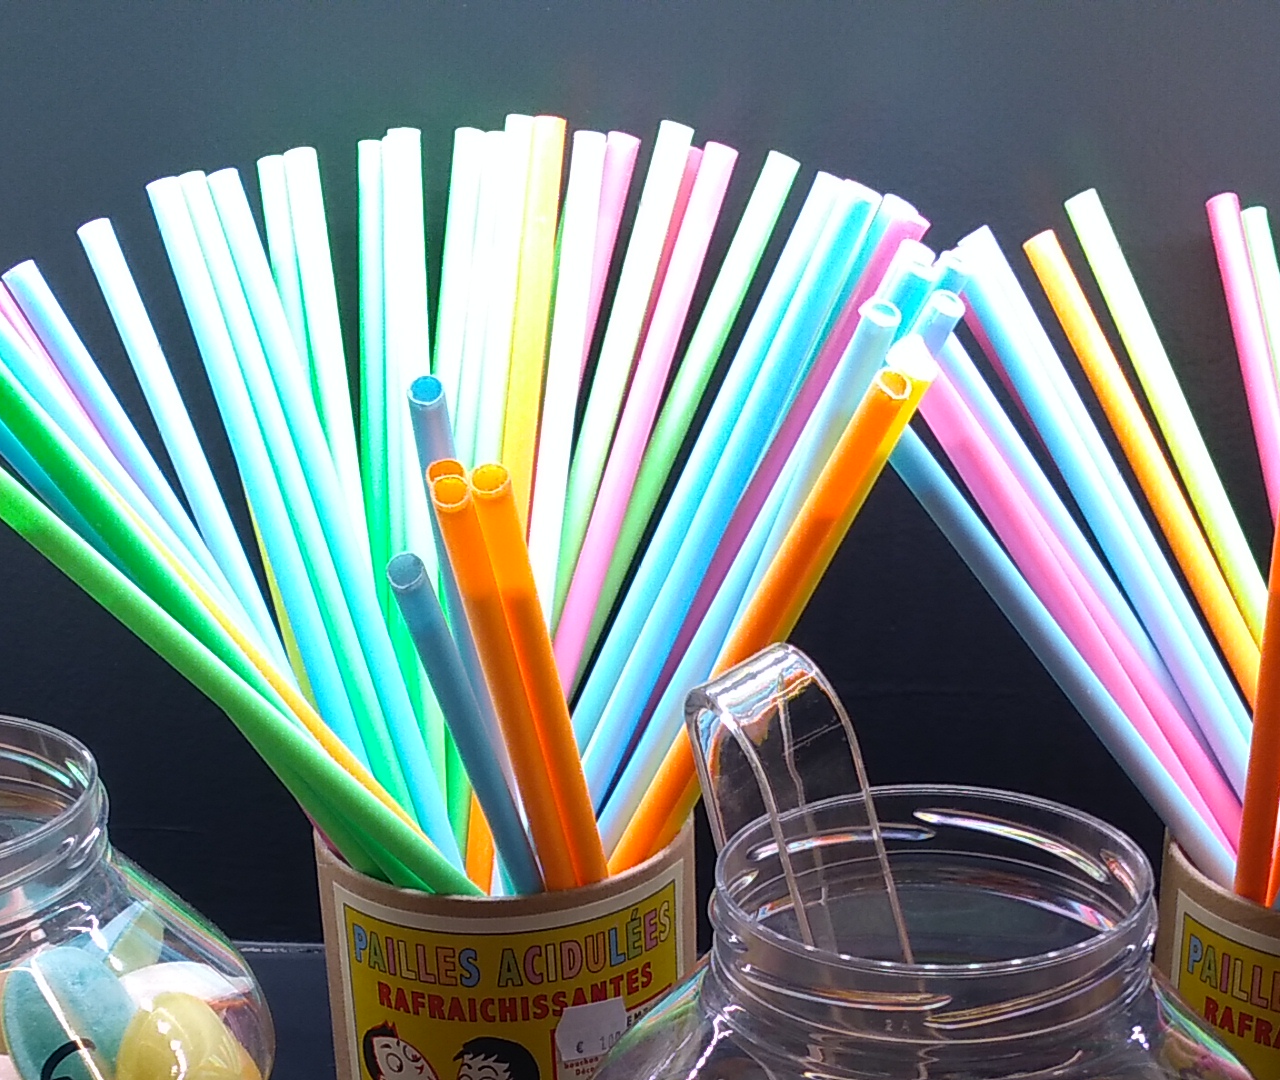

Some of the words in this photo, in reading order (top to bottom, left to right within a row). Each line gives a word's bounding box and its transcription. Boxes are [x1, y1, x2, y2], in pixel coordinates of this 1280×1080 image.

[353, 922, 481, 988] PAILLES
[498, 900, 672, 988] ACIDULÉES
[377, 961, 653, 1023] RAFRAICHISSANTES
